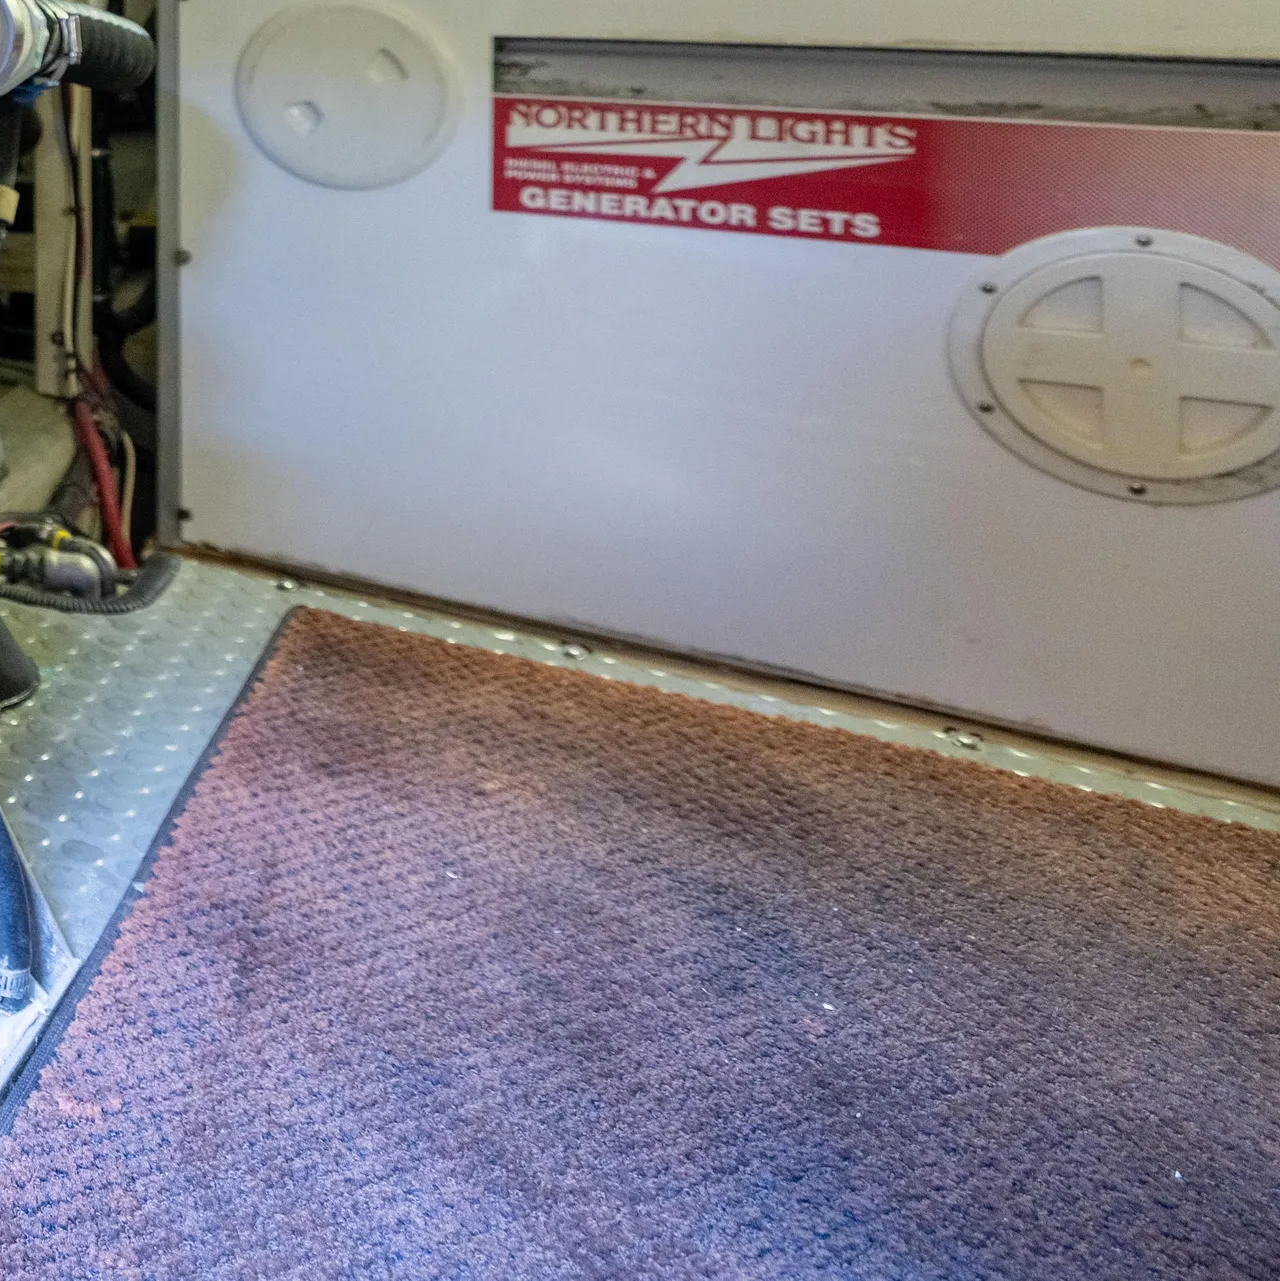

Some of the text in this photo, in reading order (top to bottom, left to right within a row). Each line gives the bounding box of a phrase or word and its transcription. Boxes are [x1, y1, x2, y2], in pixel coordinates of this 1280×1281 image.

[512, 103, 918, 150] NORTHERN LIGHTS
[519, 186, 882, 238] GENERATOR SETS
